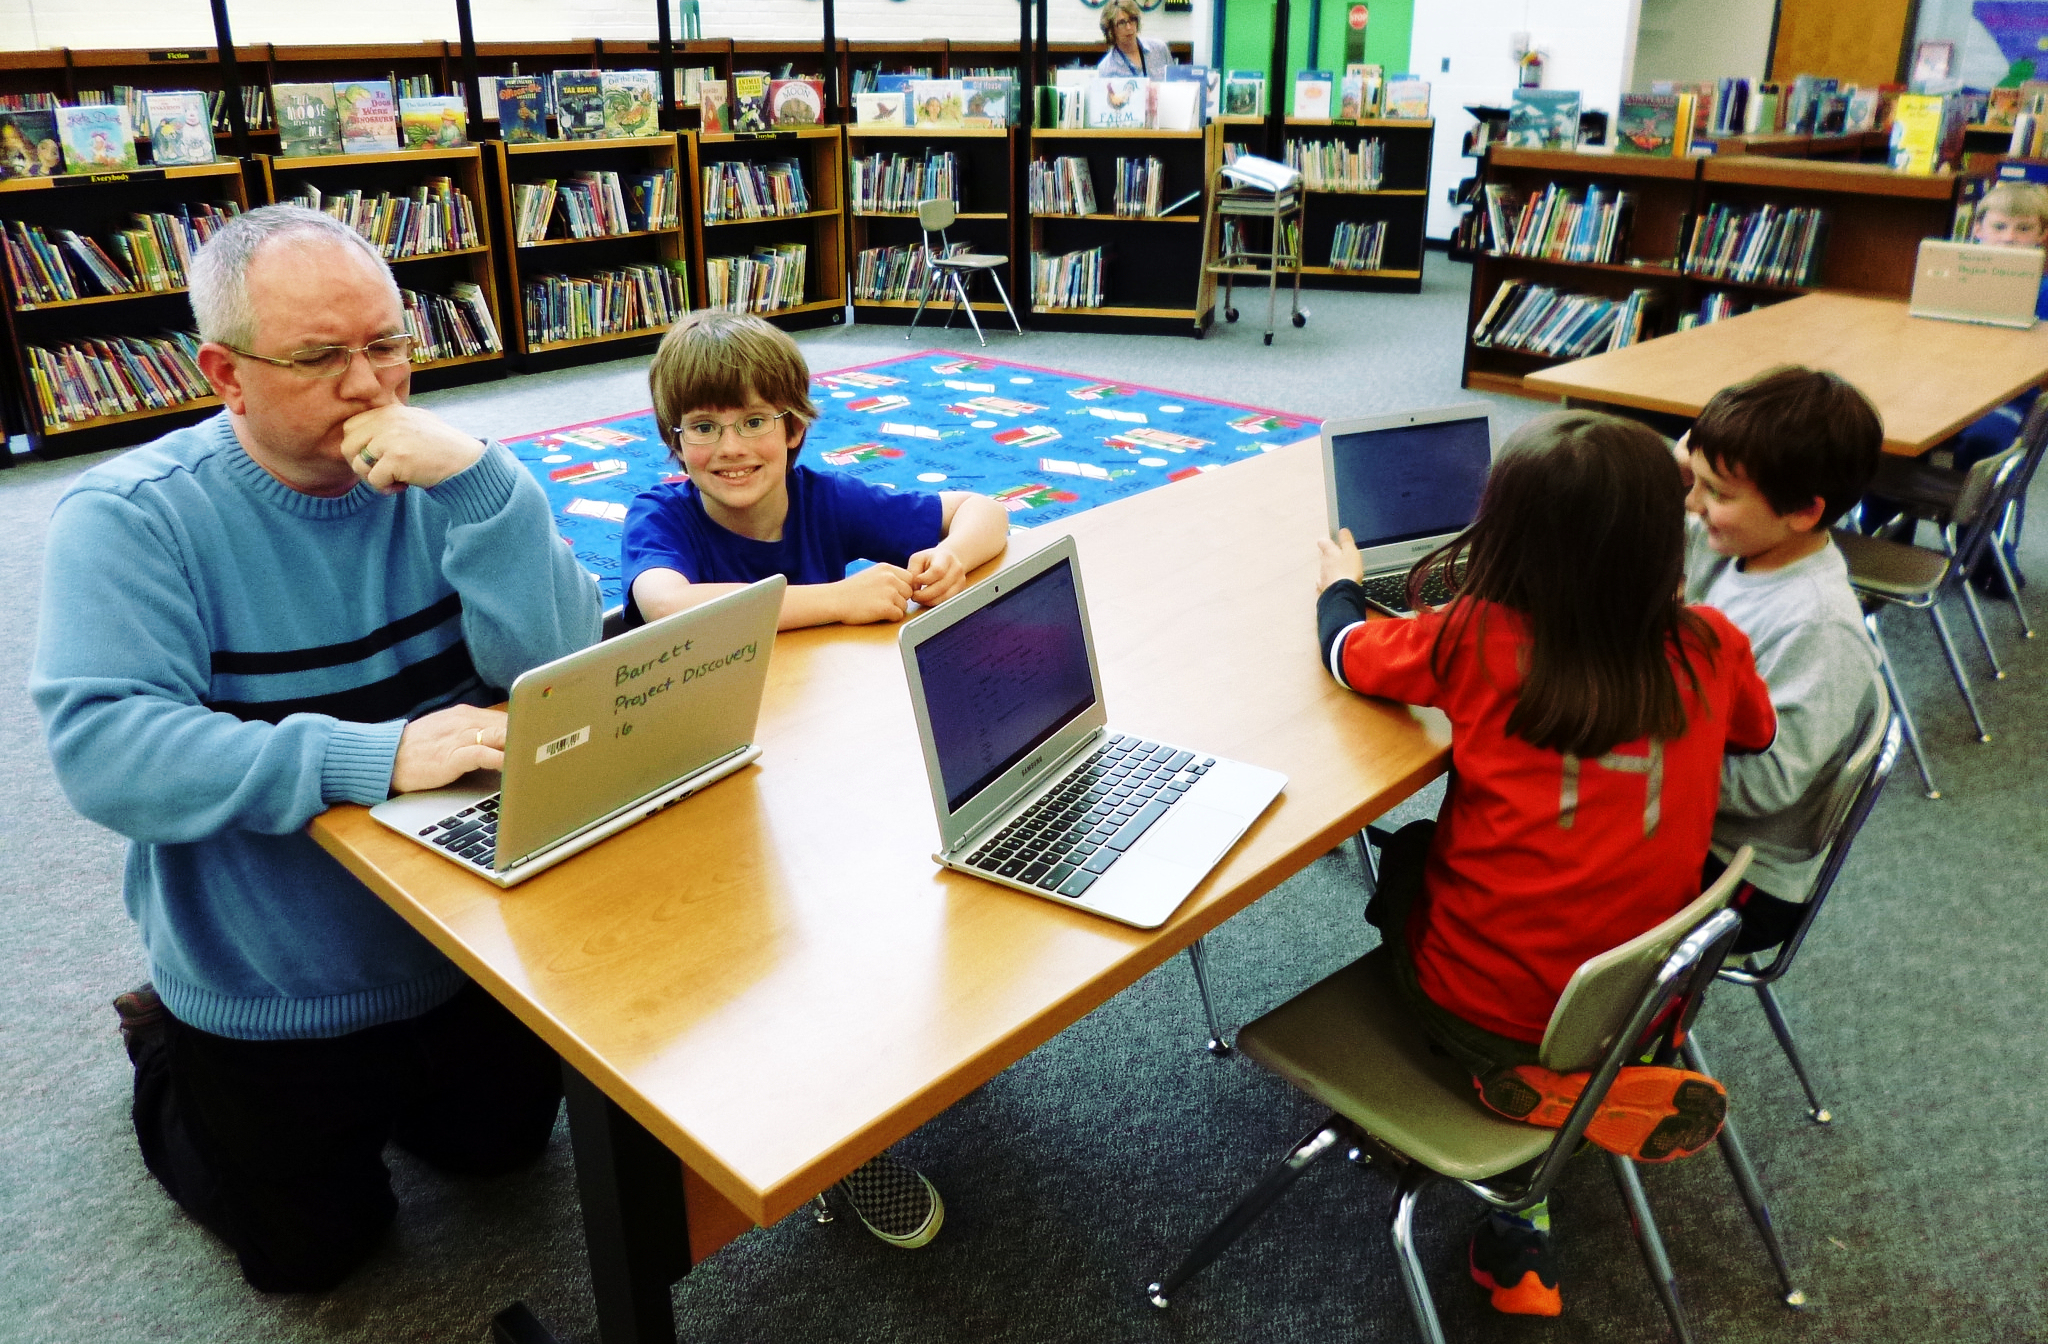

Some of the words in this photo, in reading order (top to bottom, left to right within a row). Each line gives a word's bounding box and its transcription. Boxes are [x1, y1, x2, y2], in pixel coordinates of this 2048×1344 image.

[1350, 12, 1368, 22] STOP
[167, 52, 190, 60] Fiction
[577, 86, 597, 94] BEACH
[782, 86, 811, 98] MOON
[287, 103, 326, 121] MOOSE
[1100, 112, 1134, 123] FARM
[308, 125, 323, 138] ME
[91, 173, 129, 183] Everybody
[1023, 507, 1074, 526] READ
[575, 551, 622, 571] READ
[615, 639, 695, 687] Barrett
[614, 677, 675, 716] Project
[682, 641, 758, 685] Discovery
[615, 722, 633, 739] 16
[1021, 755, 1044, 778] SAMSUNG
